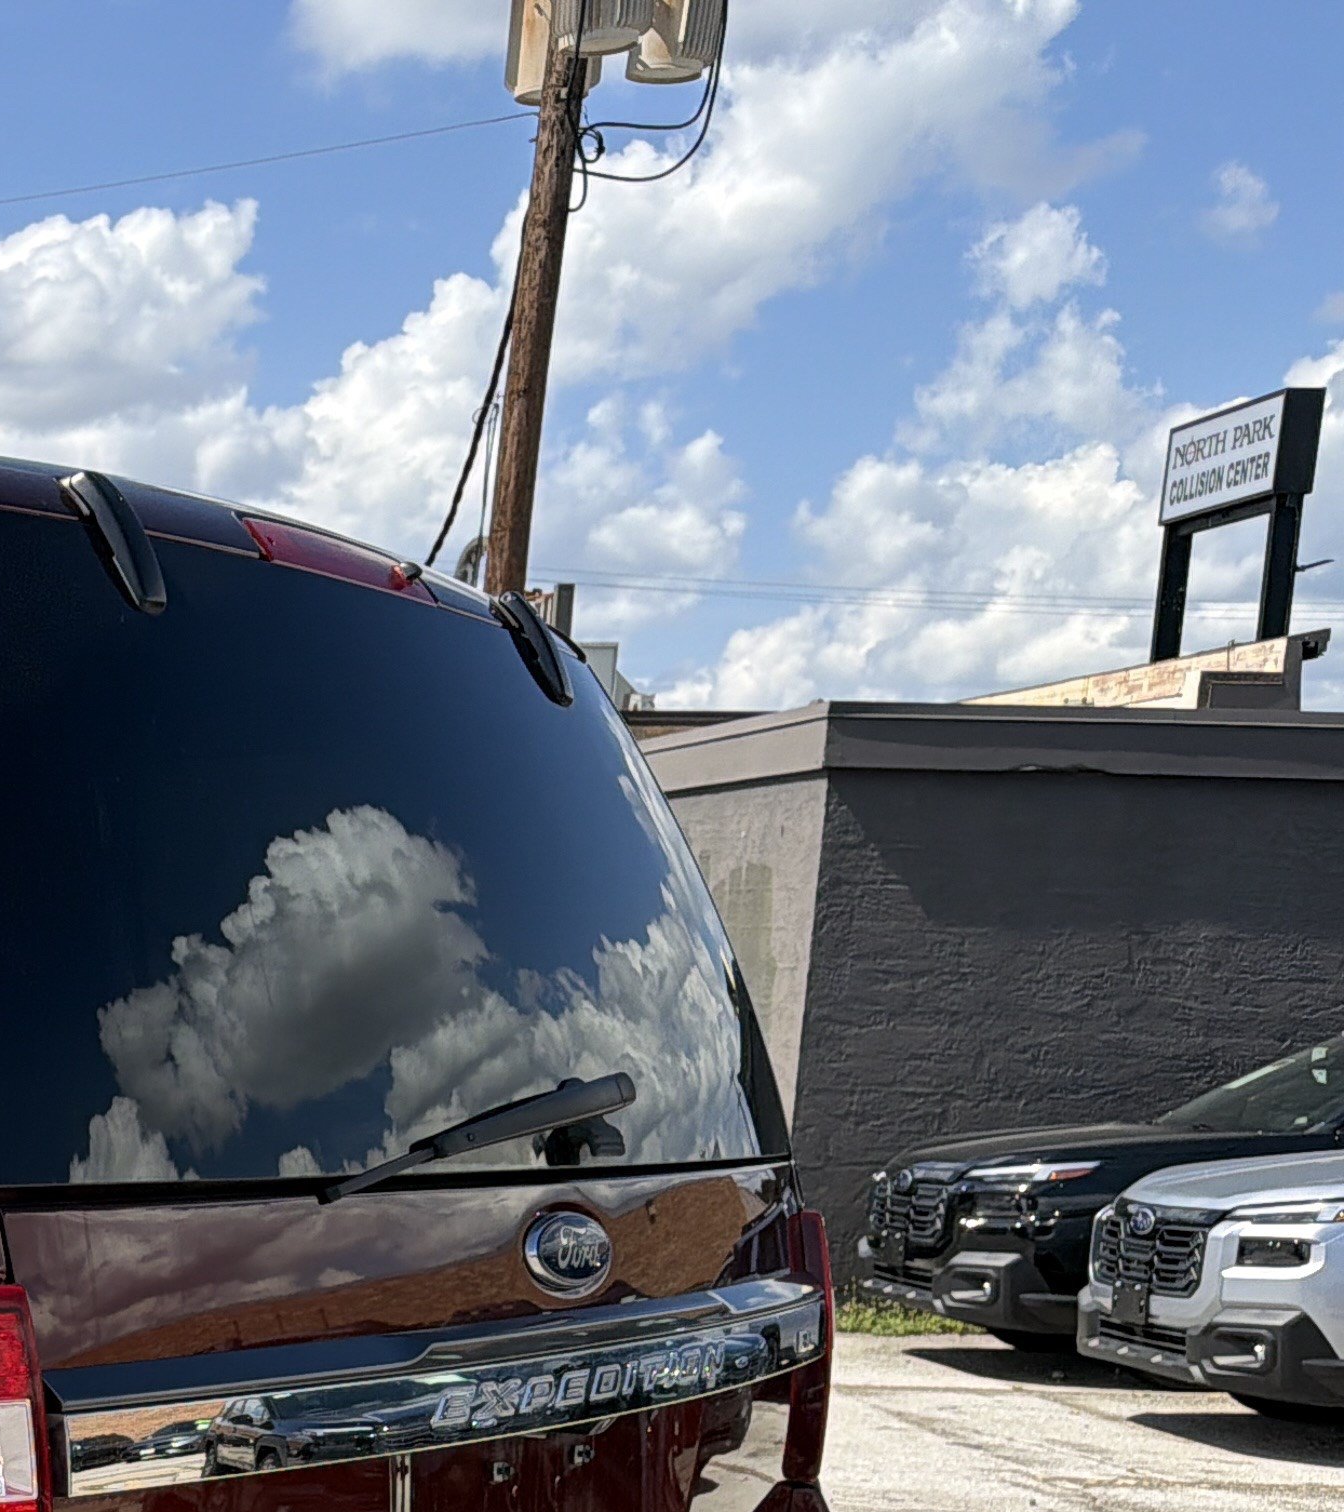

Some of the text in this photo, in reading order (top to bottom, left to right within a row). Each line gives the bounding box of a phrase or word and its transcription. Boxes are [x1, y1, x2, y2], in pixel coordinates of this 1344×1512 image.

[1173, 414, 1276, 469] NORTH PARK
[1169, 452, 1271, 506] COLLISION CENTER
[558, 1226, 604, 1269] Ford
[429, 1339, 727, 1430] EXPEDITION
